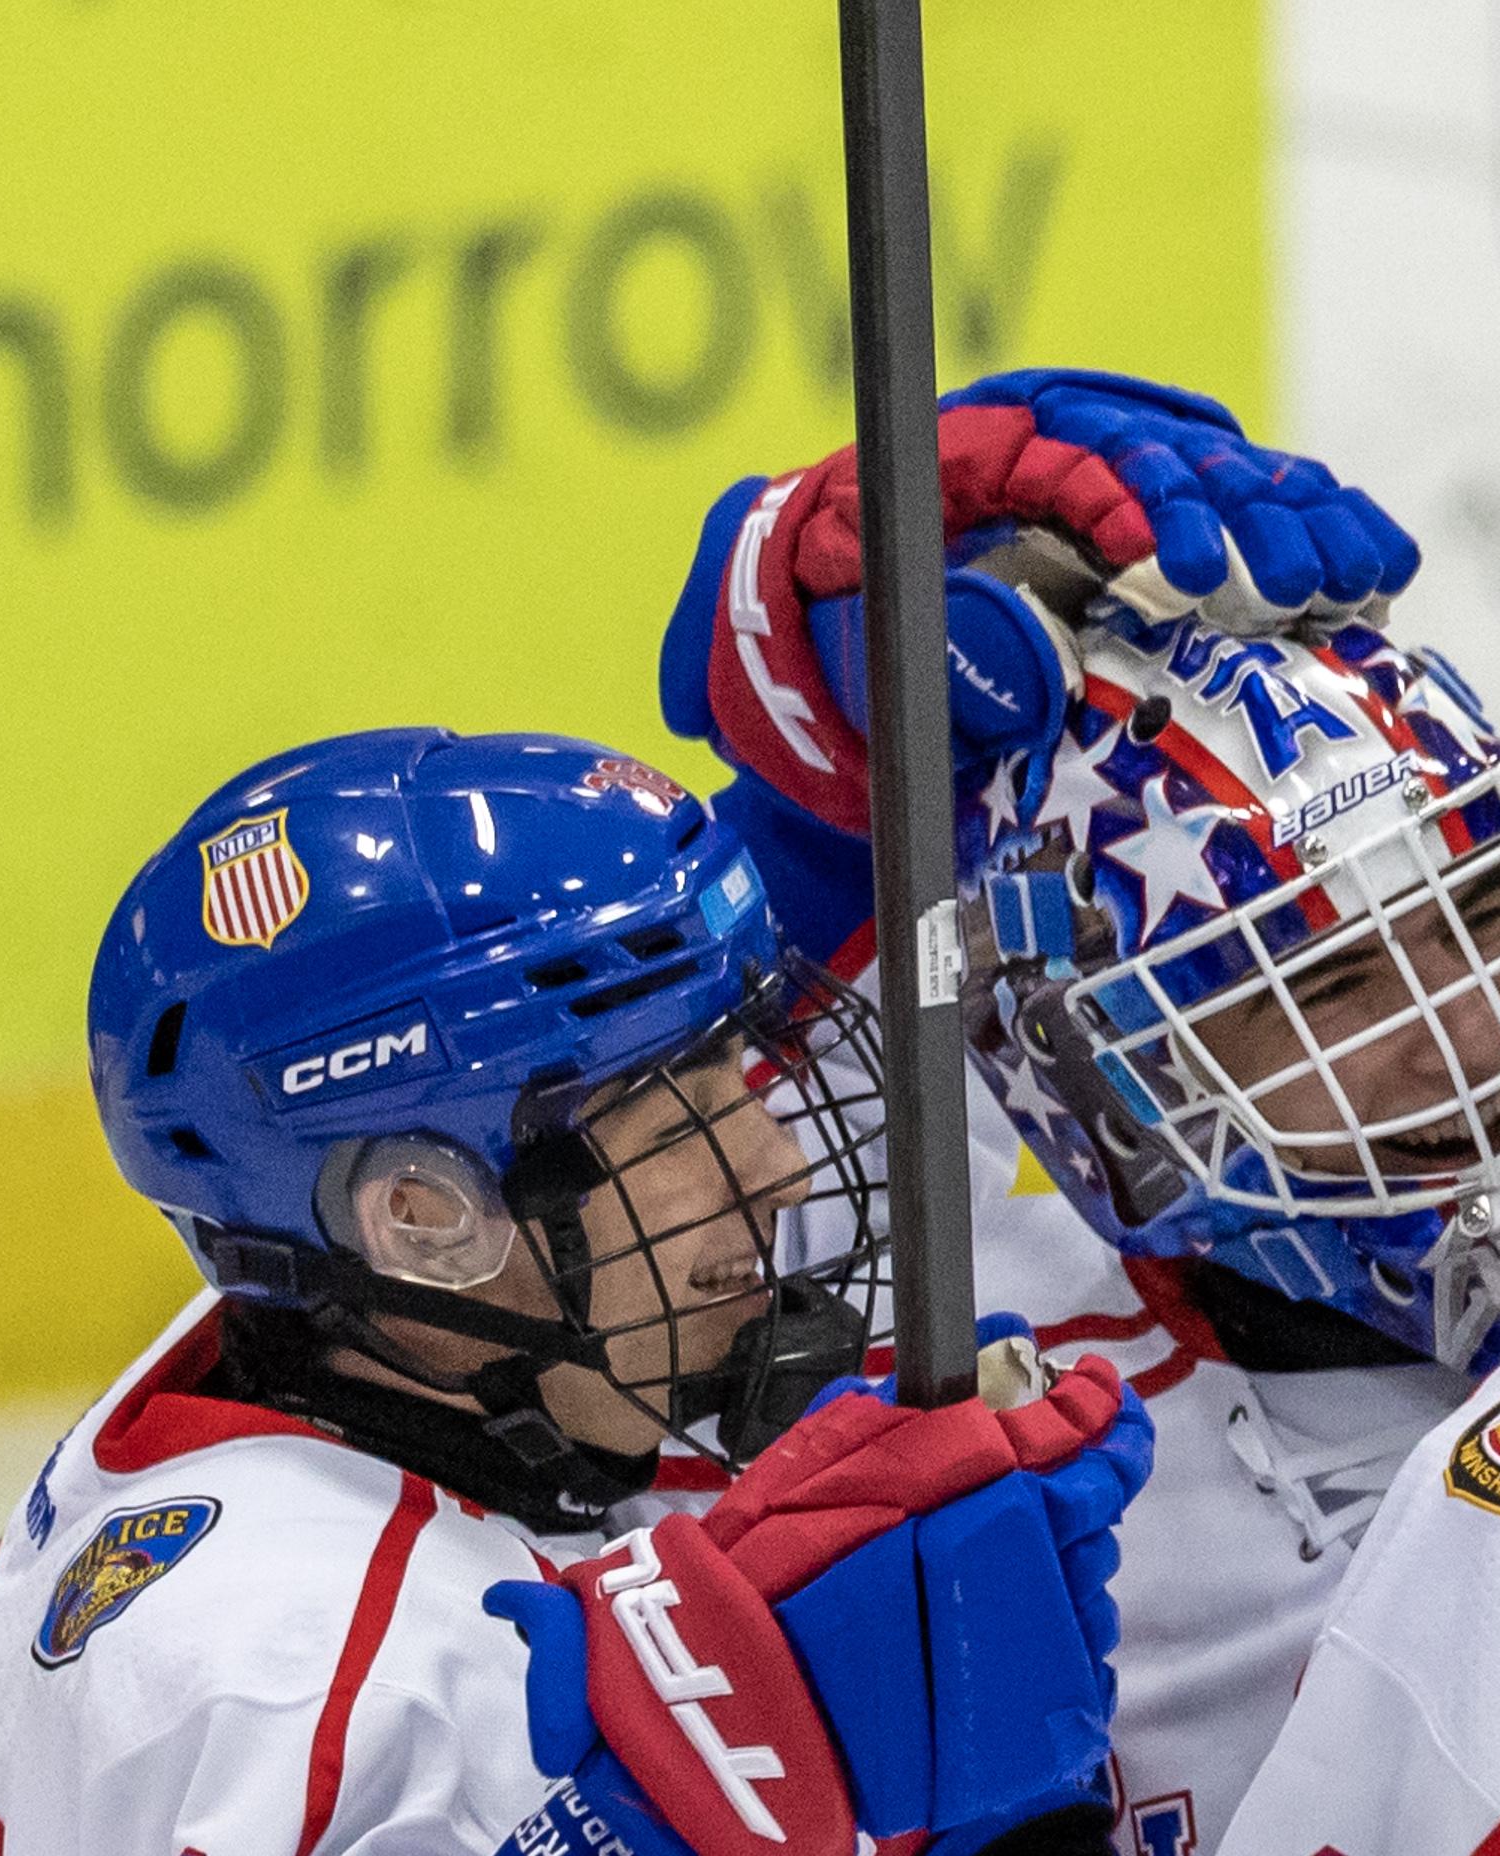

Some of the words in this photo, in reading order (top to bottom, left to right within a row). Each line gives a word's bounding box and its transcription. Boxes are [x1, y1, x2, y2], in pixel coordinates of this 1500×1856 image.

[211, 821, 276, 865] NTDP
[282, 1023, 428, 1095] CCM
[595, 1522, 789, 1845] TRU
